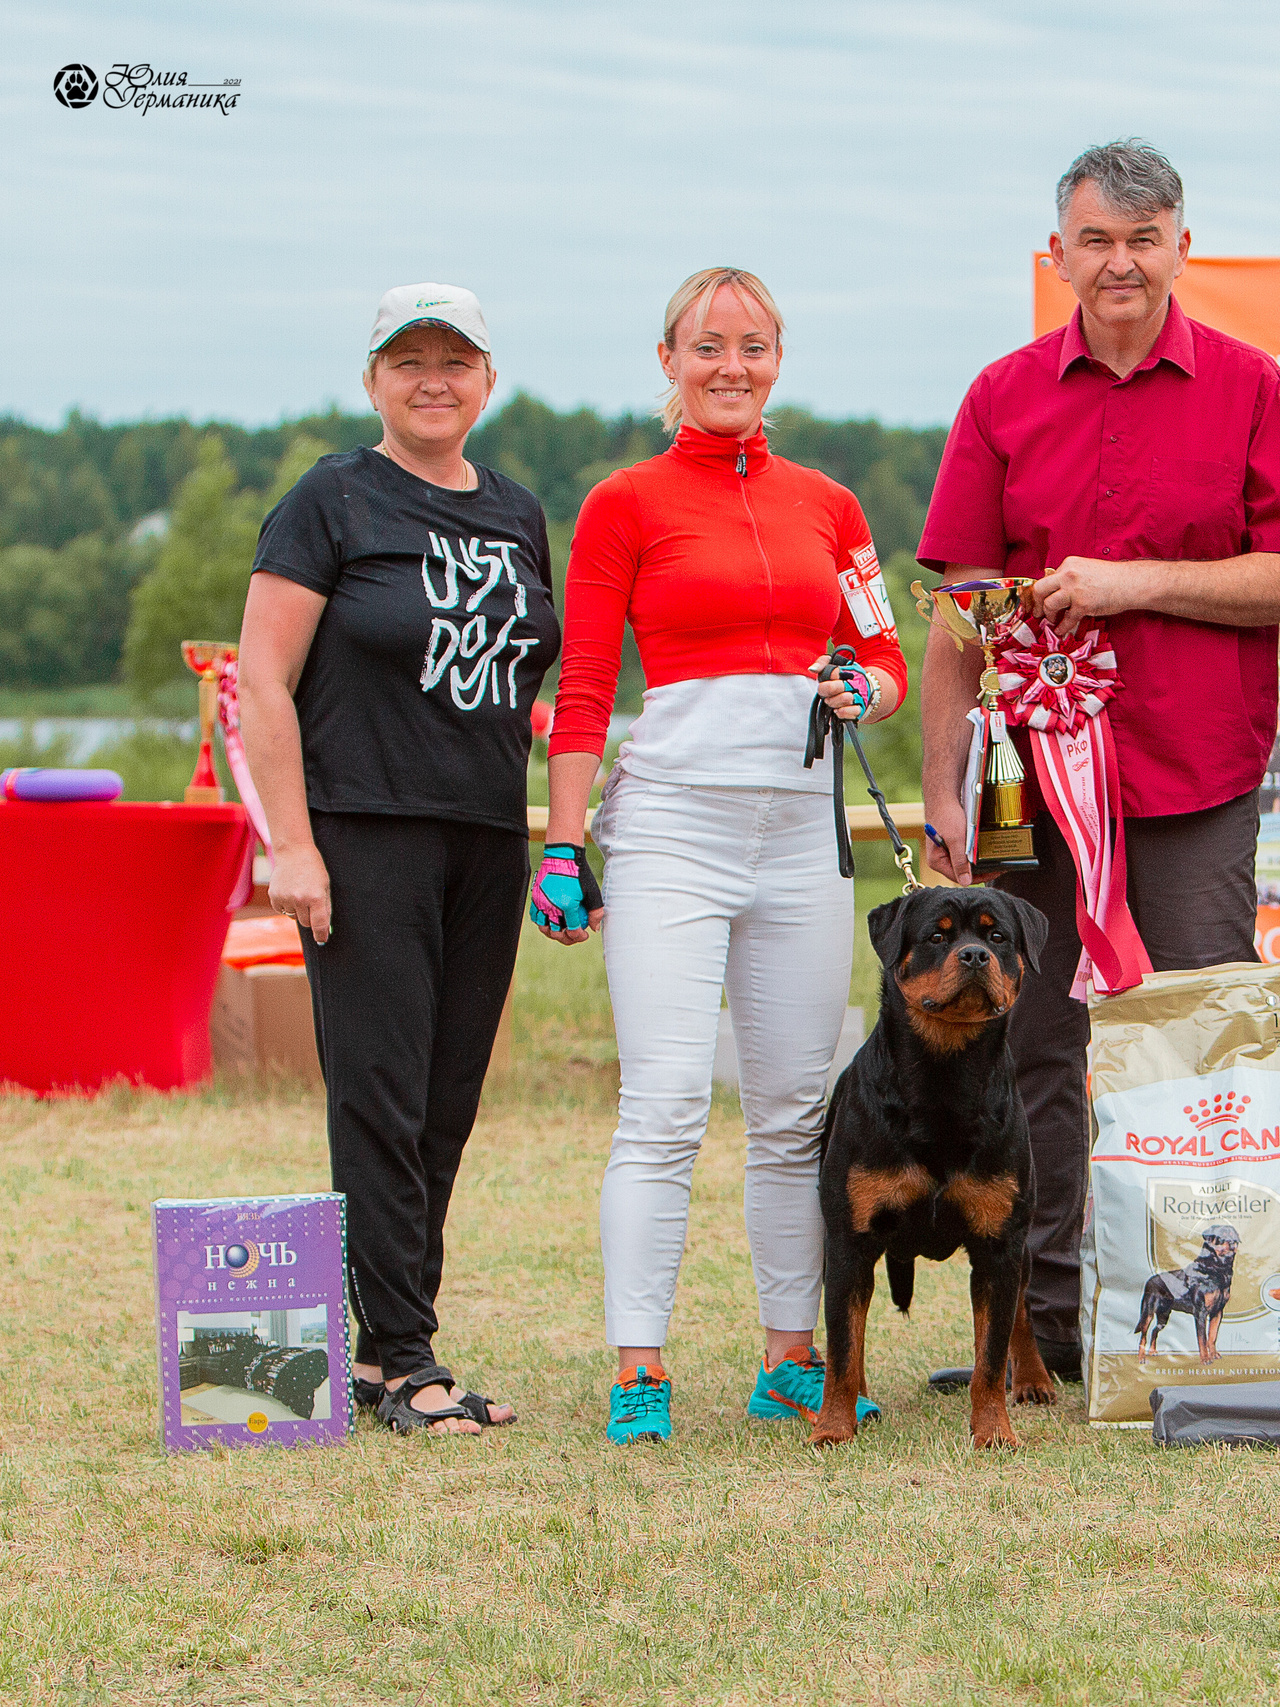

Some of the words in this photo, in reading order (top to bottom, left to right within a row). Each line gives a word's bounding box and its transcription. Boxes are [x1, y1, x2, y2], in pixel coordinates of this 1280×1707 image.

[421, 531, 528, 618] JUST
[1066, 740, 1088, 758] РКФ
[1126, 1131, 1214, 1157] ROYAL
[1199, 1182, 1232, 1194] ADULT
[1163, 1195, 1271, 1215] Rottweiler
[207, 1277, 296, 1292] нежна
[1155, 1367, 1184, 1376] BREED
[1188, 1367, 1225, 1376] HEALTH
